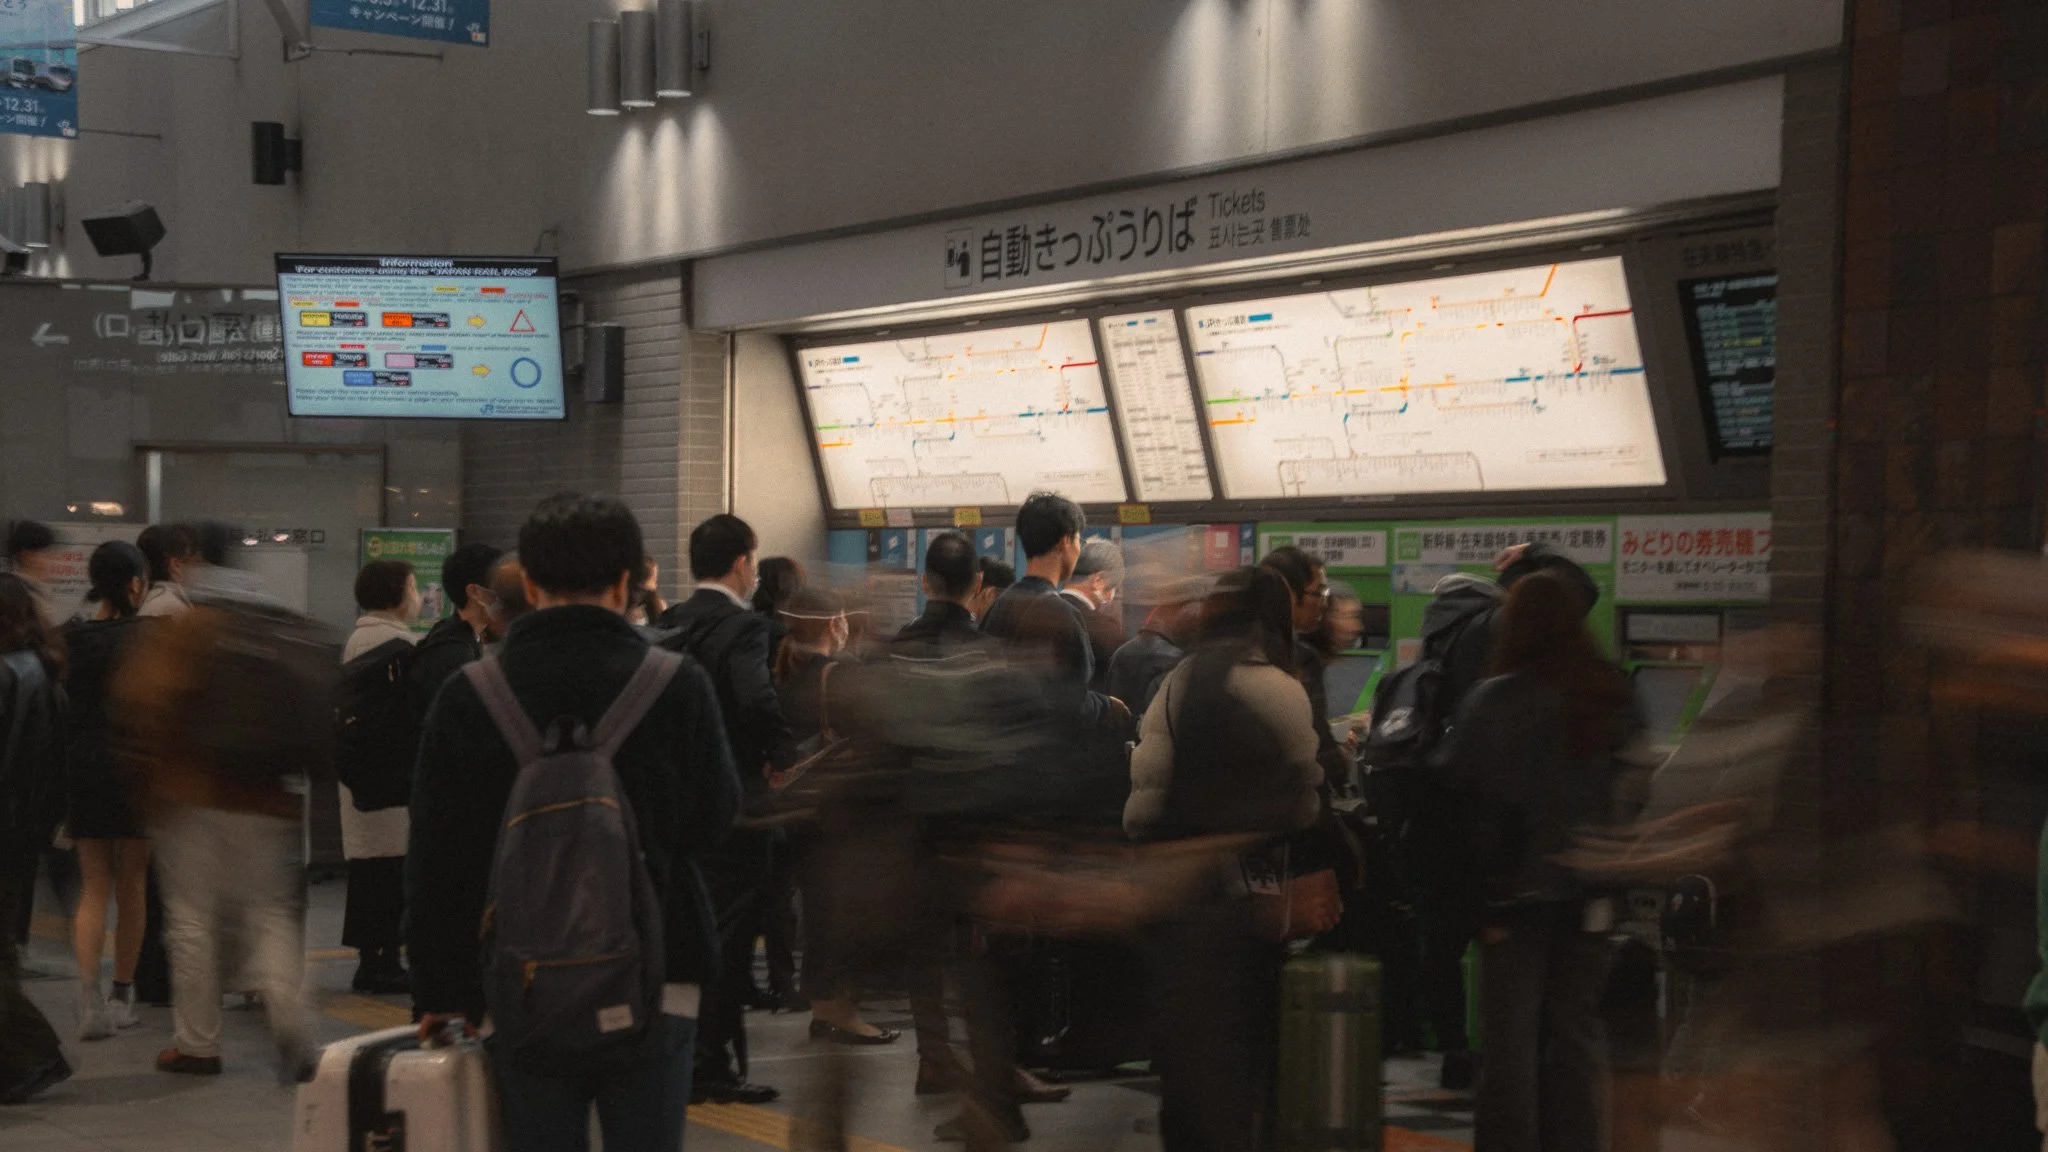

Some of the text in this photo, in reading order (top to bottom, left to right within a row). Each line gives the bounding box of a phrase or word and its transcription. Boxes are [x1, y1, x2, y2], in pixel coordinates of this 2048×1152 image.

[1209, 188, 1266, 218] Tickets
[980, 196, 1200, 282] 自動きっぷうりば
[295, 264, 318, 274] For
[318, 266, 375, 275] customers
[378, 268, 407, 277] using
[411, 267, 428, 275] the
[474, 268, 500, 276] RAIL
[379, 257, 454, 268] Information
